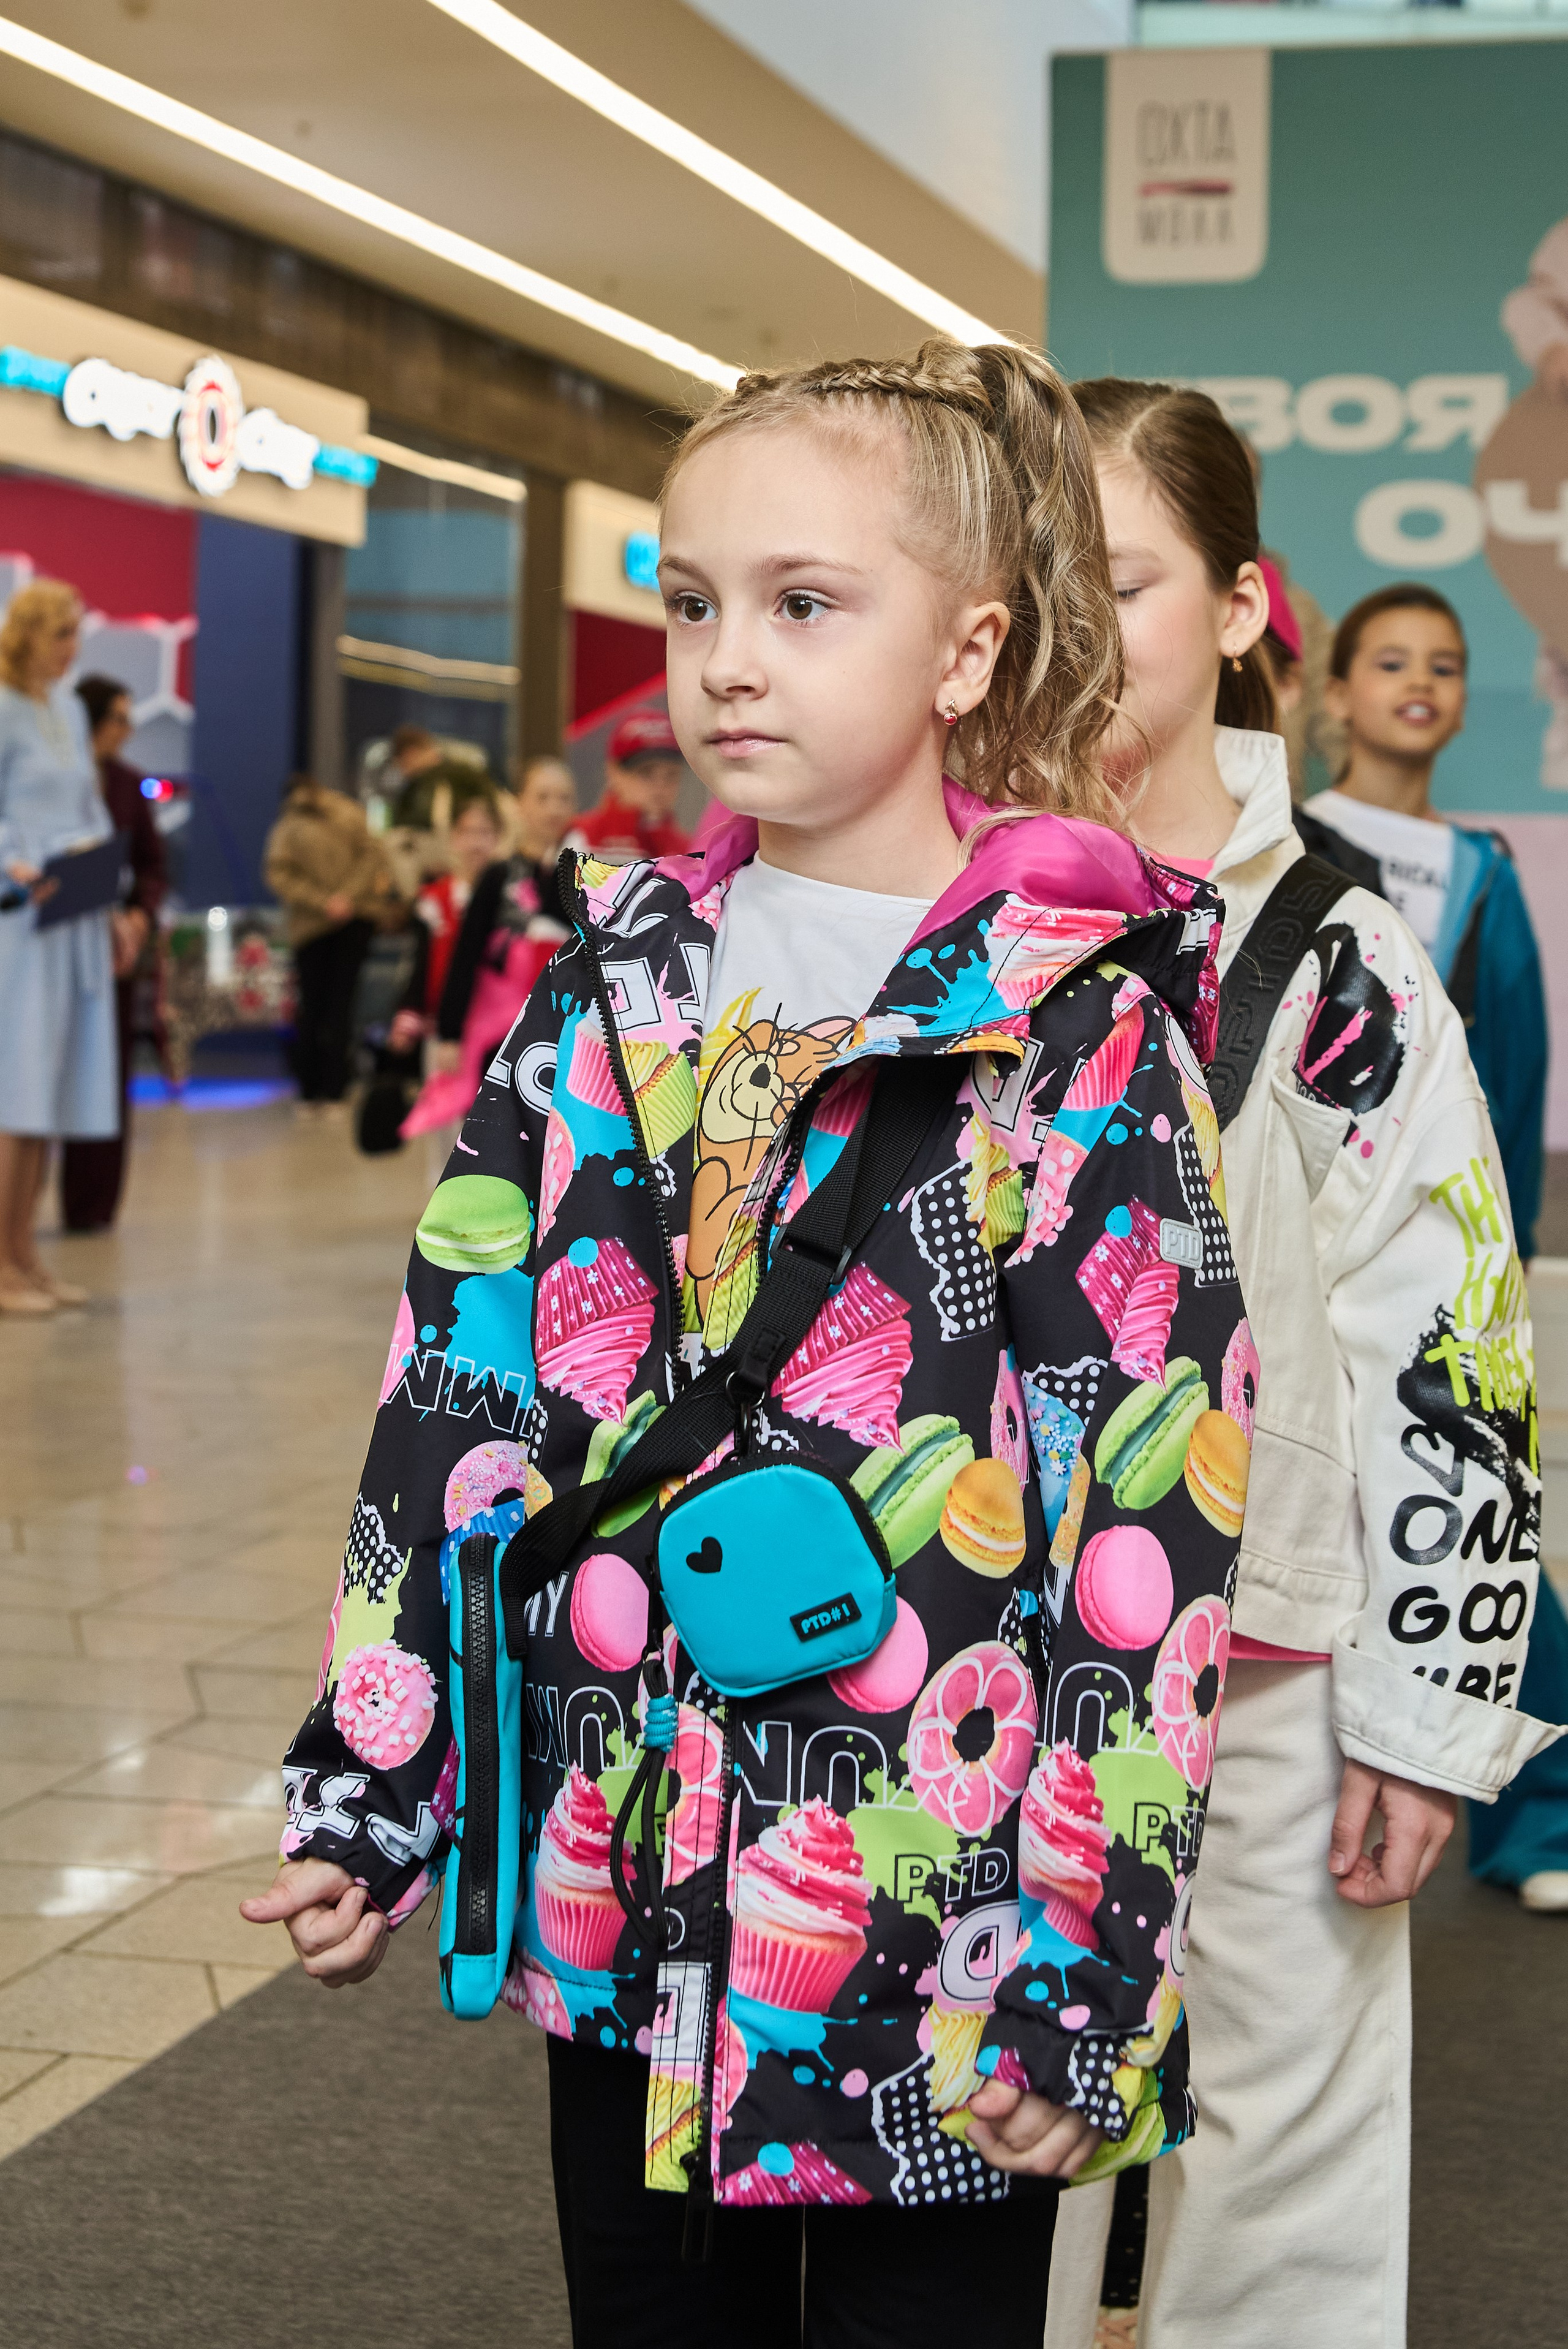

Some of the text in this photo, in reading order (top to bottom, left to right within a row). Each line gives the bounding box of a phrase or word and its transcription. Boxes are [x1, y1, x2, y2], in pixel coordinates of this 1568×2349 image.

[1139, 373, 1509, 455] ВОЯ
[1429, 1156, 1504, 1259] TH
[1164, 1225, 1201, 1262] PTD
[1389, 1580, 1526, 1644] GOO
[895, 1847, 1010, 1902] PTD
